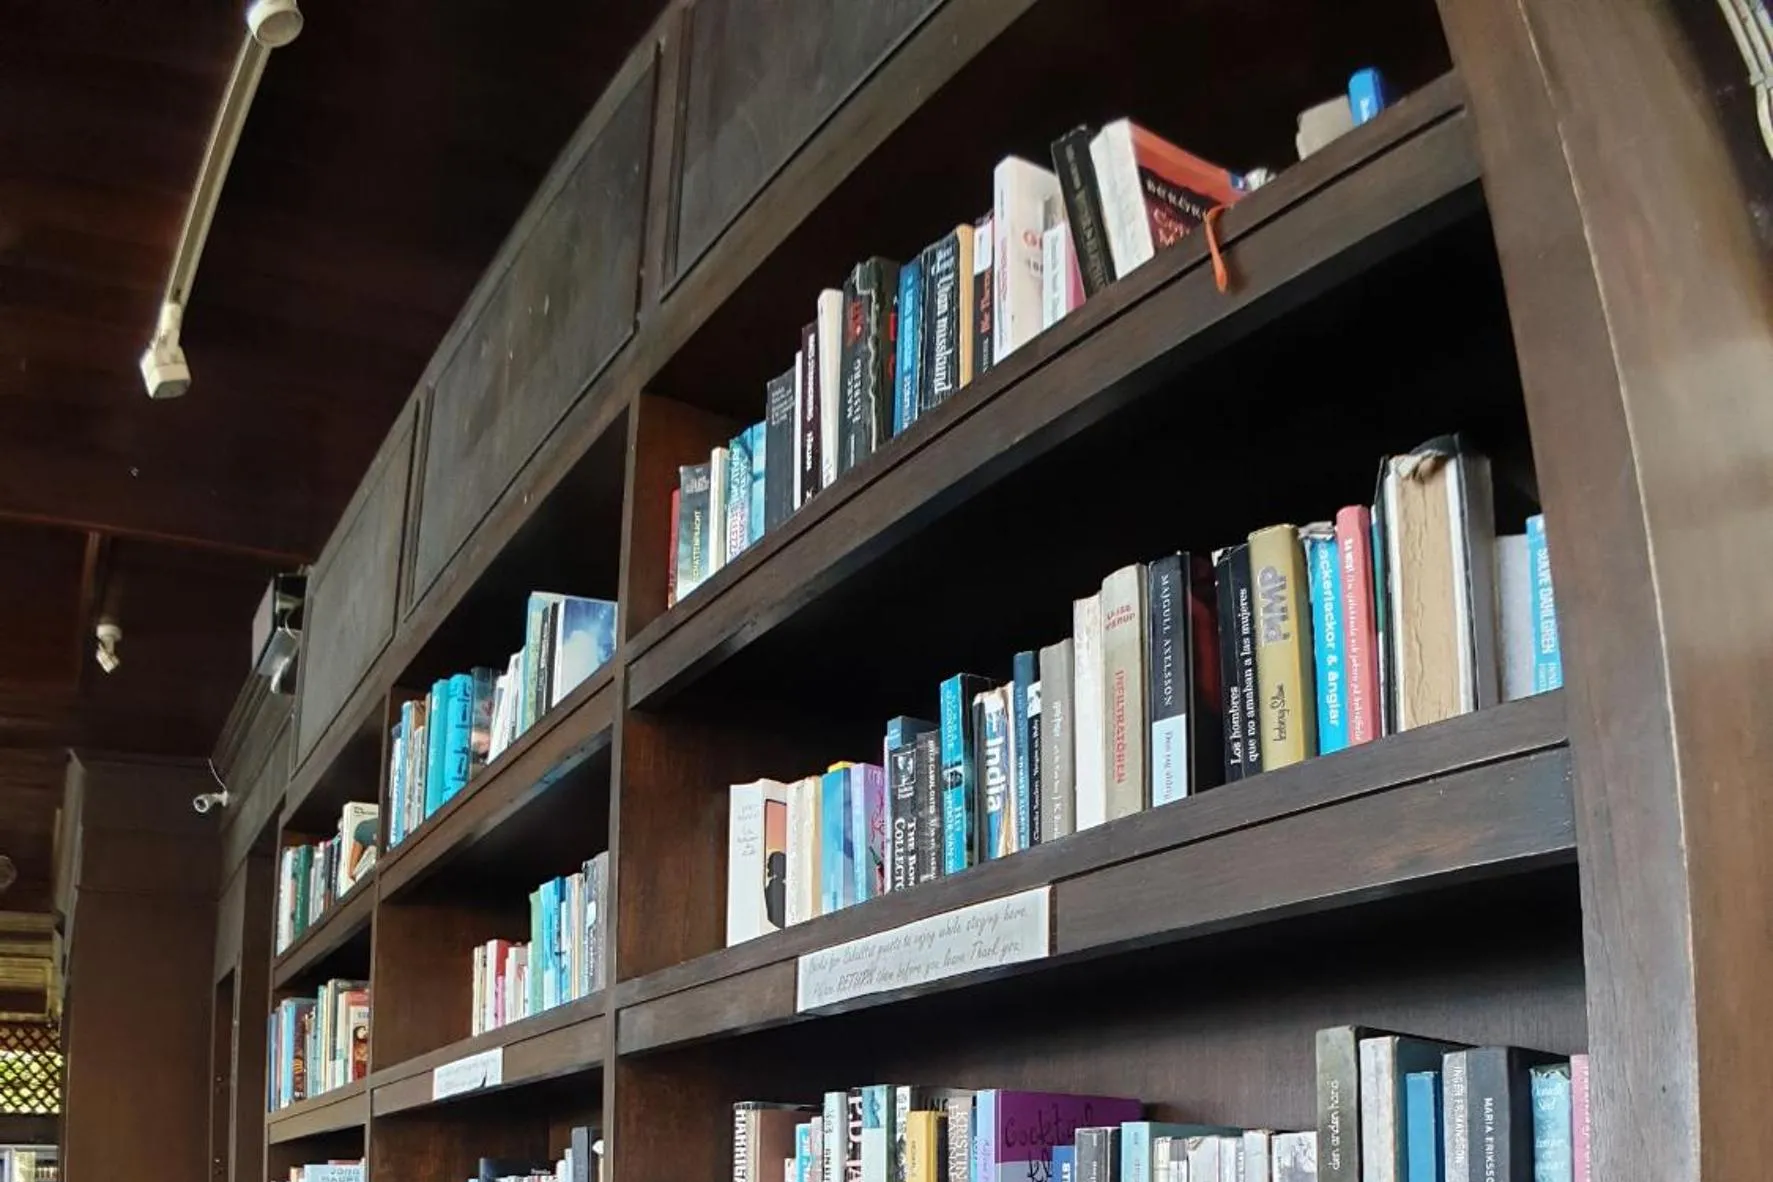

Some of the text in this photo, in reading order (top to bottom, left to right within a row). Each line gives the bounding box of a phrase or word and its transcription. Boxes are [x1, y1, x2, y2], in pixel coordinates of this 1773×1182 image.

[1161, 575, 1174, 707] MAJGULL AXELSSON
[1238, 588, 1260, 762] que no amaban a las mujeres
[1326, 671, 1341, 729] änglar
[1228, 686, 1242, 765] Los hombres
[986, 740, 1006, 812] India
[938, 917, 963, 939] while
[966, 910, 1001, 935] staying
[838, 967, 875, 992] RETURN
[896, 960, 923, 981] before
[969, 940, 999, 961] Thank
[1452, 1065, 1464, 1096] INGER
[1483, 1097, 1494, 1134] MARIA
[956, 1111, 969, 1181] KRISTIN
[1329, 1149, 1341, 1171] den
